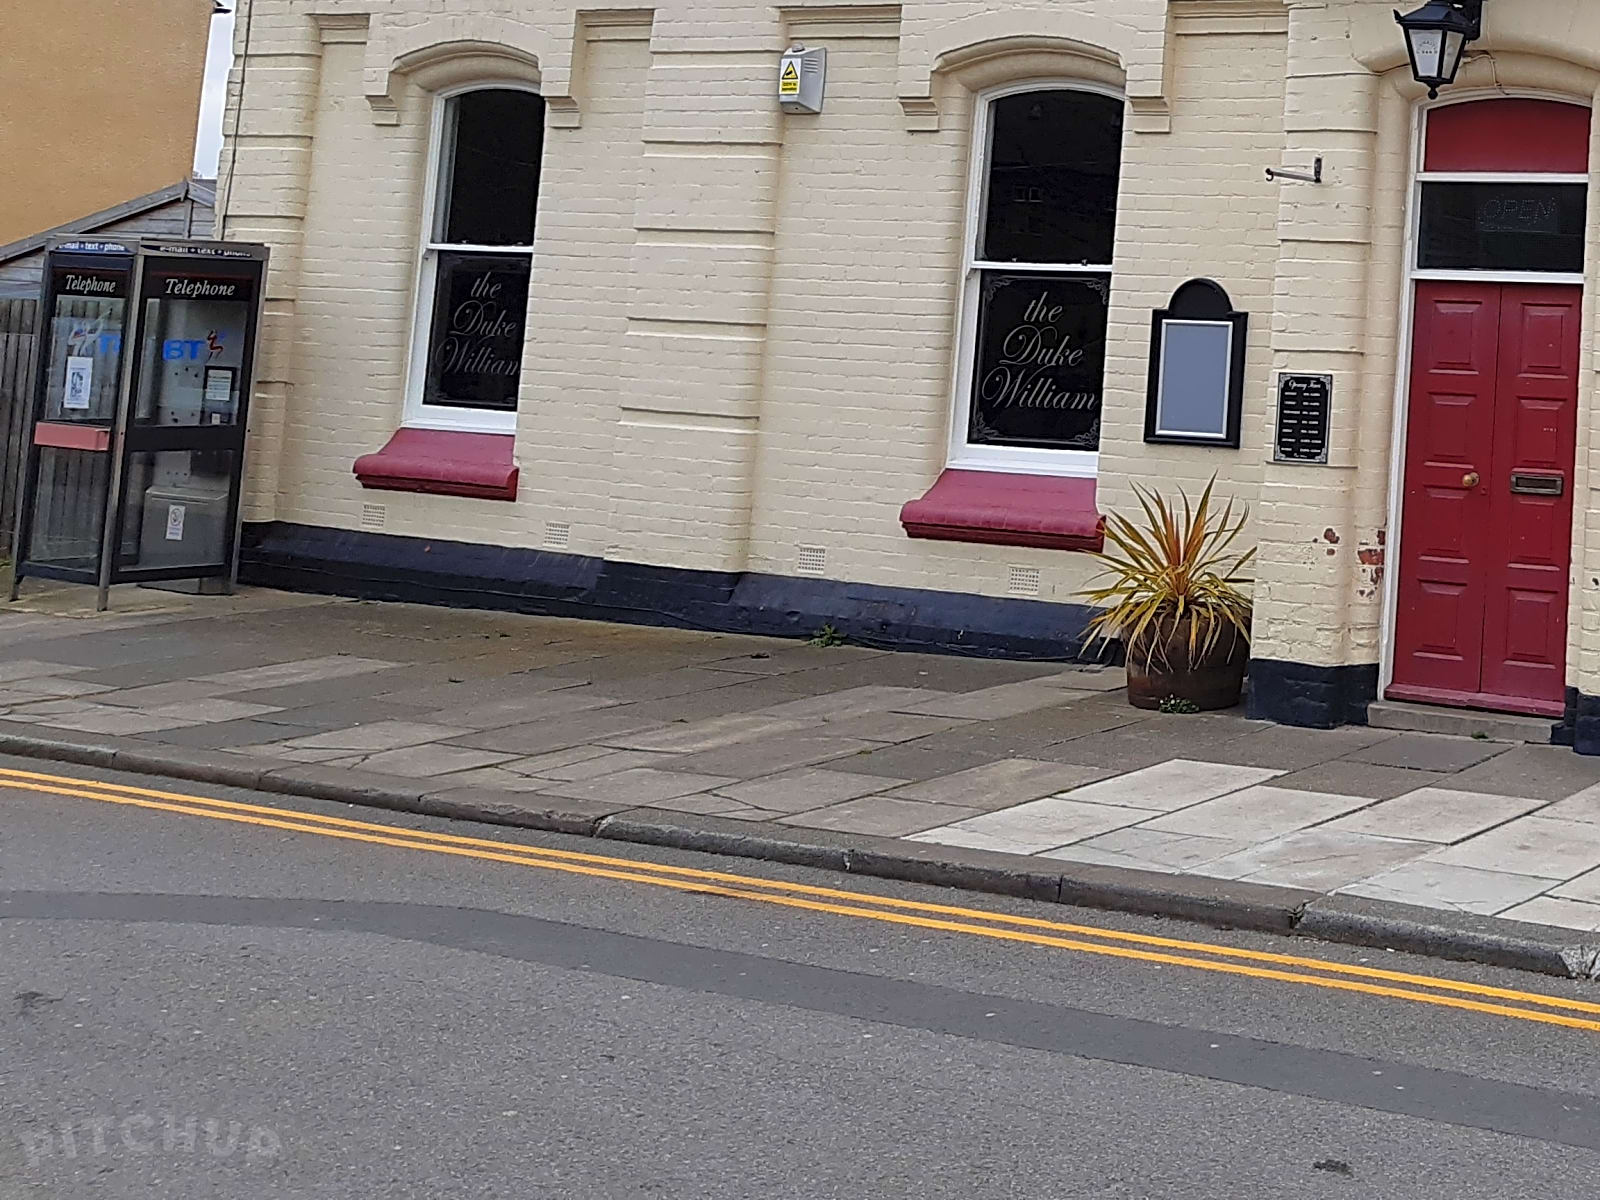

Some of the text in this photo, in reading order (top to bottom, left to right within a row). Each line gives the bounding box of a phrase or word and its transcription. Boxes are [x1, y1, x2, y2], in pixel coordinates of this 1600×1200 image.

[66, 275, 116, 294] Telephone
[165, 279, 235, 297] Telephone
[470, 271, 502, 298] the
[449, 300, 517, 337] Duke
[1023, 291, 1064, 322] the
[163, 339, 205, 360] BT
[999, 324, 1083, 366] Duke
[981, 364, 1099, 410] William
